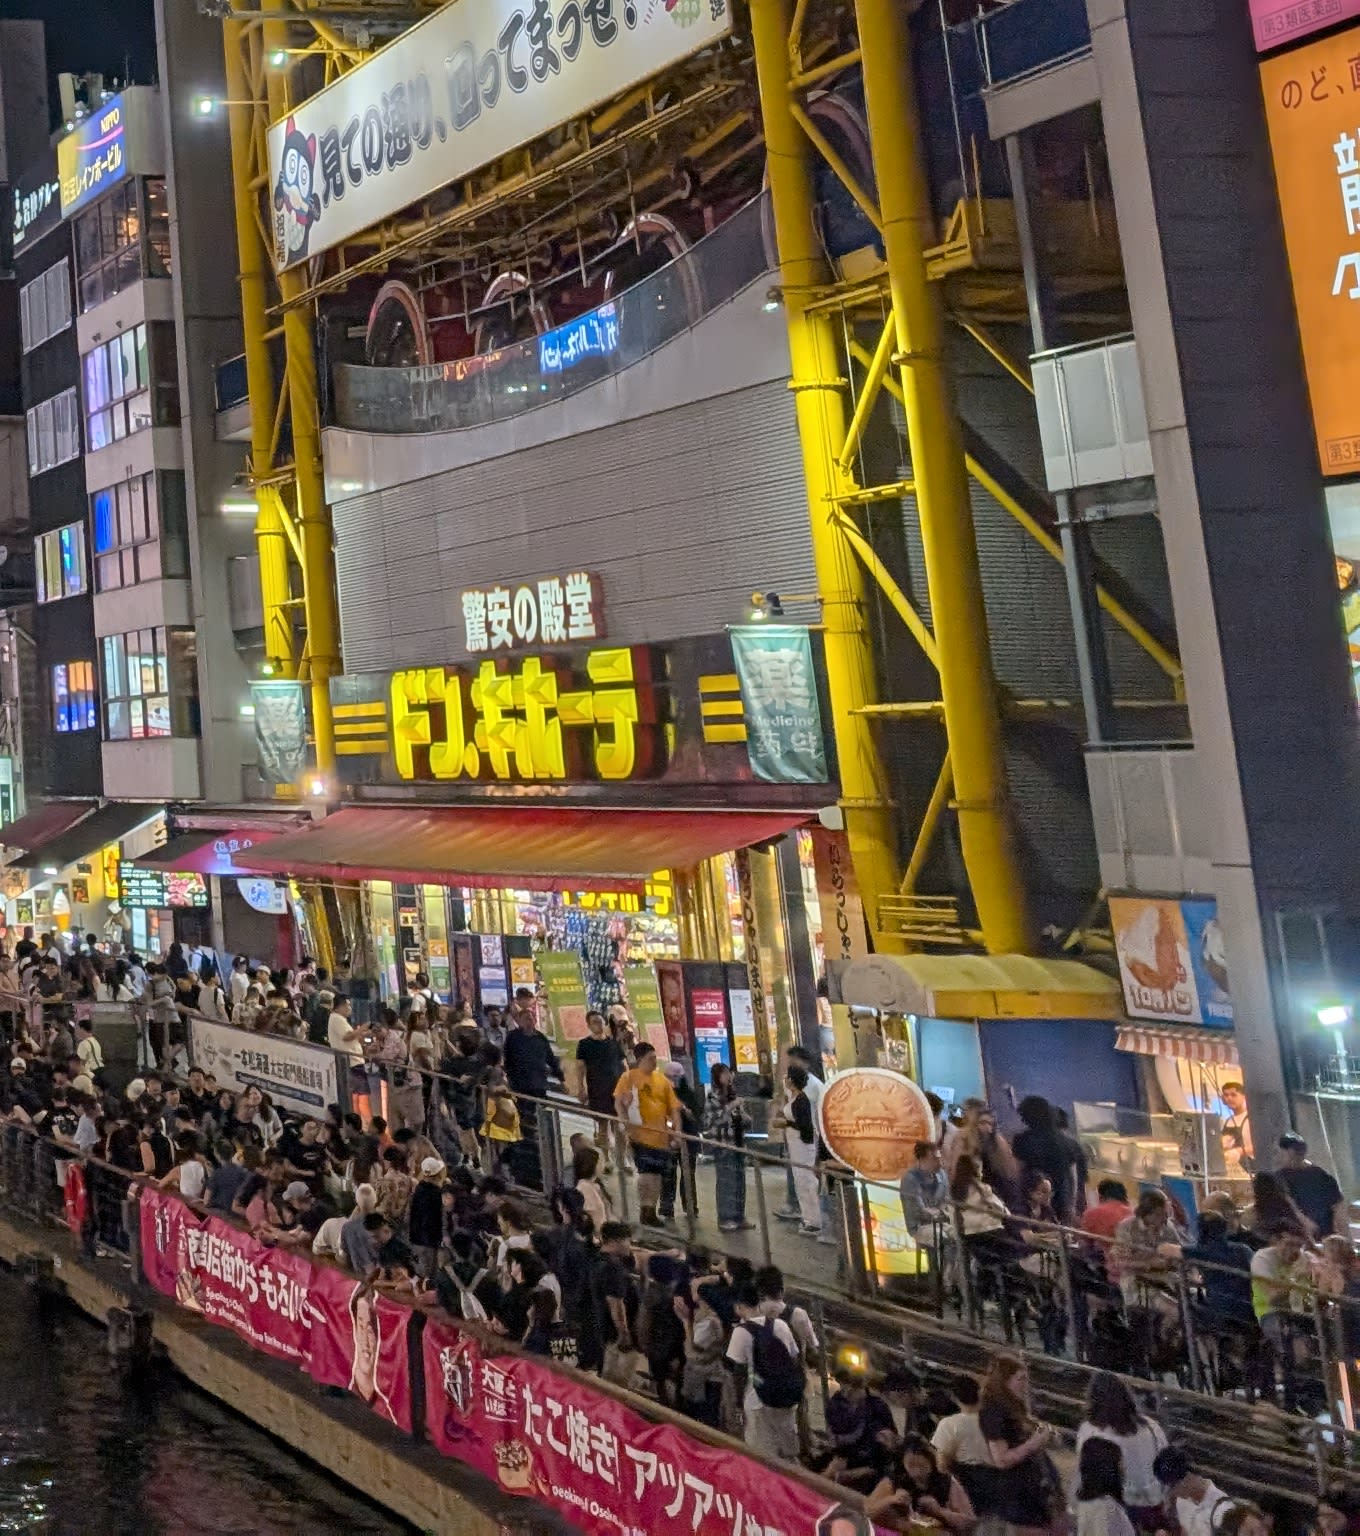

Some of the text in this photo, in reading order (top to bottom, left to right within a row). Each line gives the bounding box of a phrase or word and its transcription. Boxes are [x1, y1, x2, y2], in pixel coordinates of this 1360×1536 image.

[462, 571, 598, 652] 驚安の殿堂
[744, 647, 810, 711] 薬
[522, 1383, 616, 1486] たこ焼き
